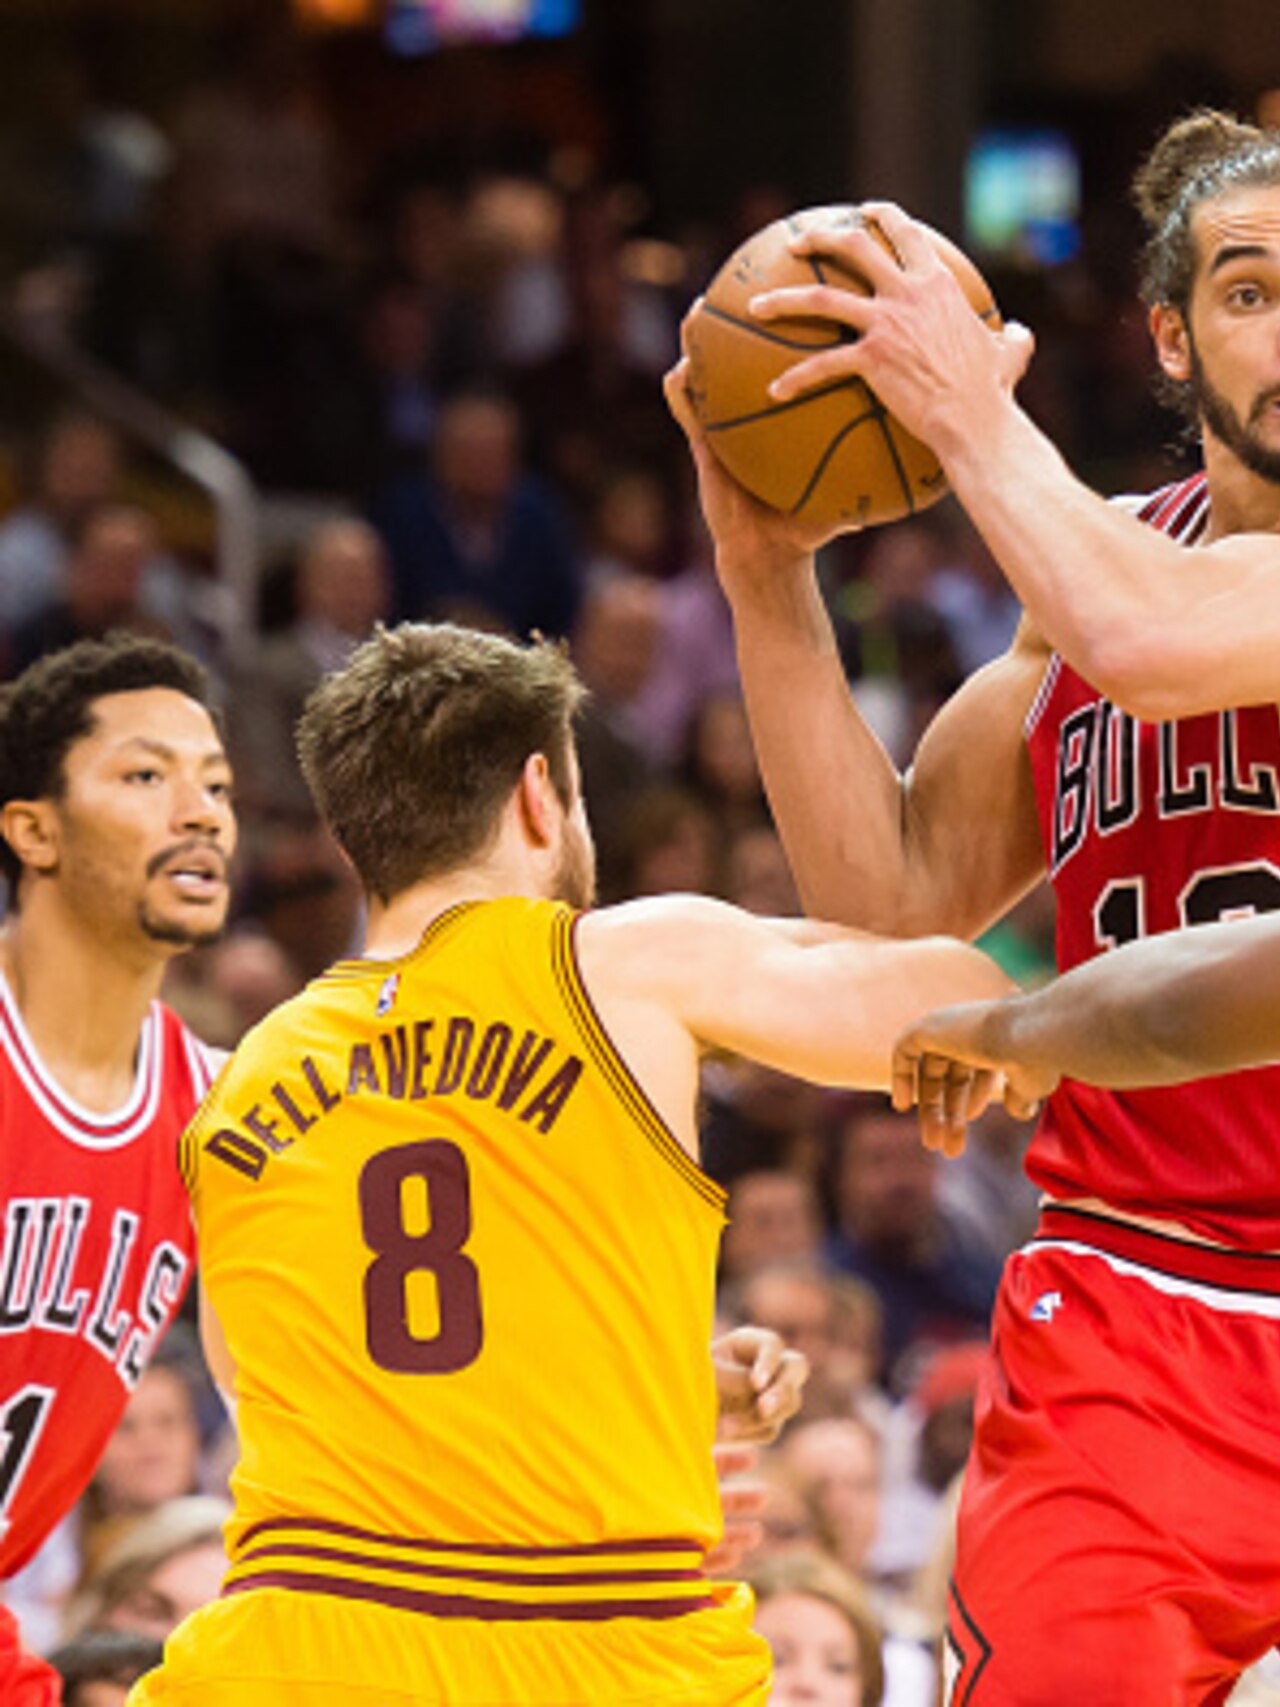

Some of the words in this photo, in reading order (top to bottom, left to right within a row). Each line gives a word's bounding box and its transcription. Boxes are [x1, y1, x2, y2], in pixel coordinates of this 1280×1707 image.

[203, 1016, 584, 1182] DELLAVEDOVA
[0, 1195, 189, 1393] ULLS
[357, 1137, 484, 1375] 8
